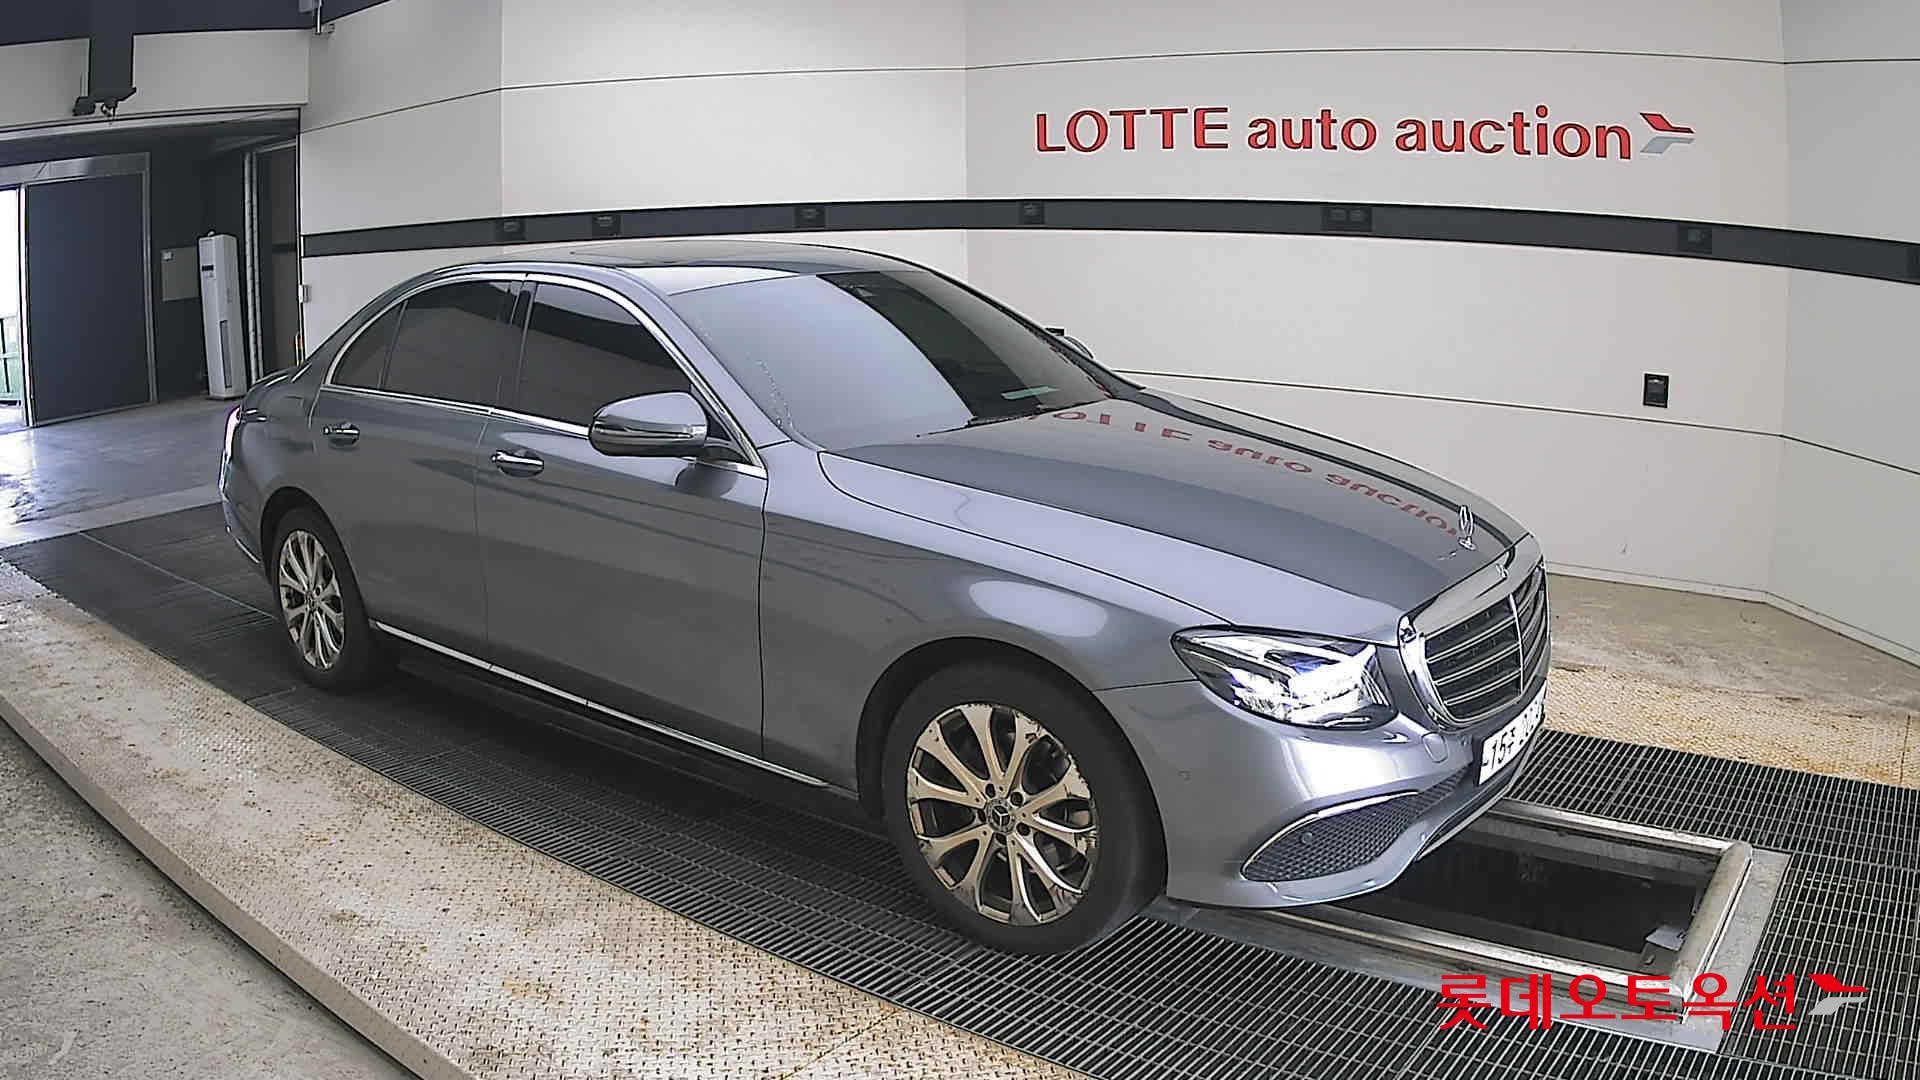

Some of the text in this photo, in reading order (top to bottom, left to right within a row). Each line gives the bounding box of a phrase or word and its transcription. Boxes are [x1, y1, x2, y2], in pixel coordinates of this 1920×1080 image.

[1036, 104, 1632, 160] LOTTE auto auction
